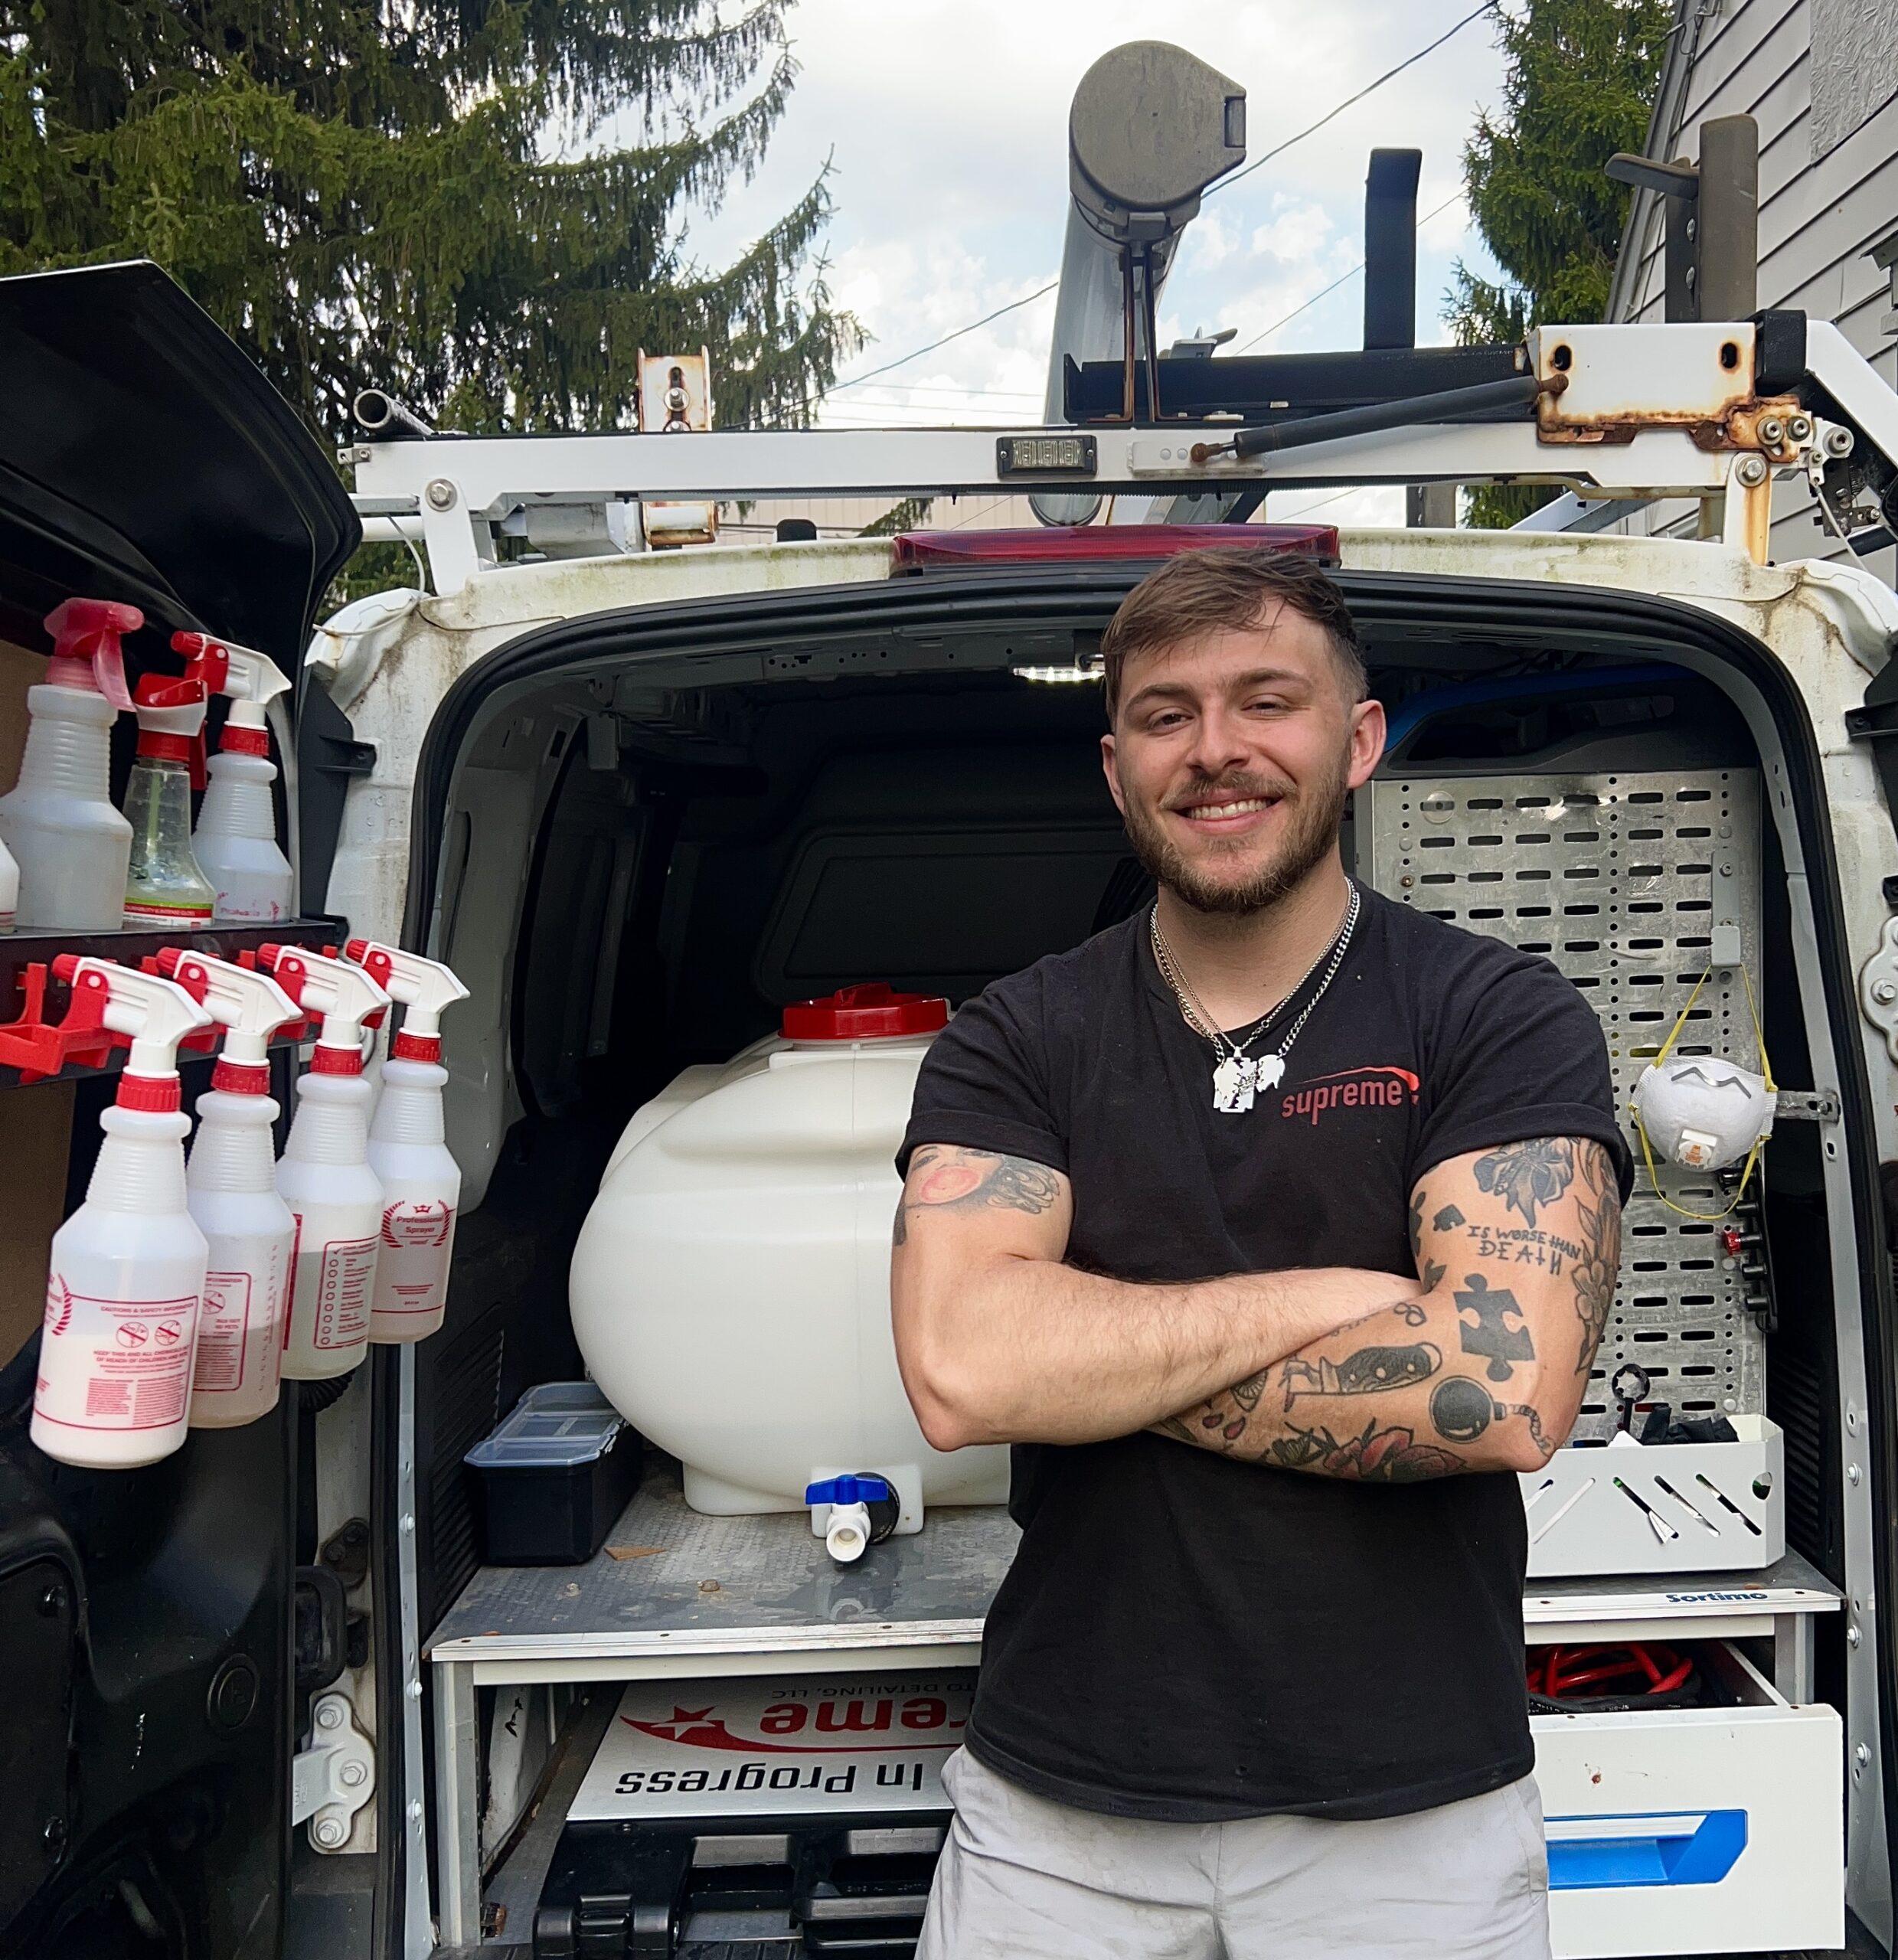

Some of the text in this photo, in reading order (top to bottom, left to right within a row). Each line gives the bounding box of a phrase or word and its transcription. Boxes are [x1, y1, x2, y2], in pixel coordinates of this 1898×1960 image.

[1282, 1080, 1403, 1126] supreme
[1467, 1226, 1490, 1239] IS
[1549, 1235, 1582, 1259] THAN
[1478, 1240, 1562, 1276] DEATH
[1665, 1592, 1768, 1602] Sortimo
[772, 1689, 807, 1699] LLC
[818, 1684, 938, 1697] DETAILING,
[614, 1762, 923, 1795] In Progress
